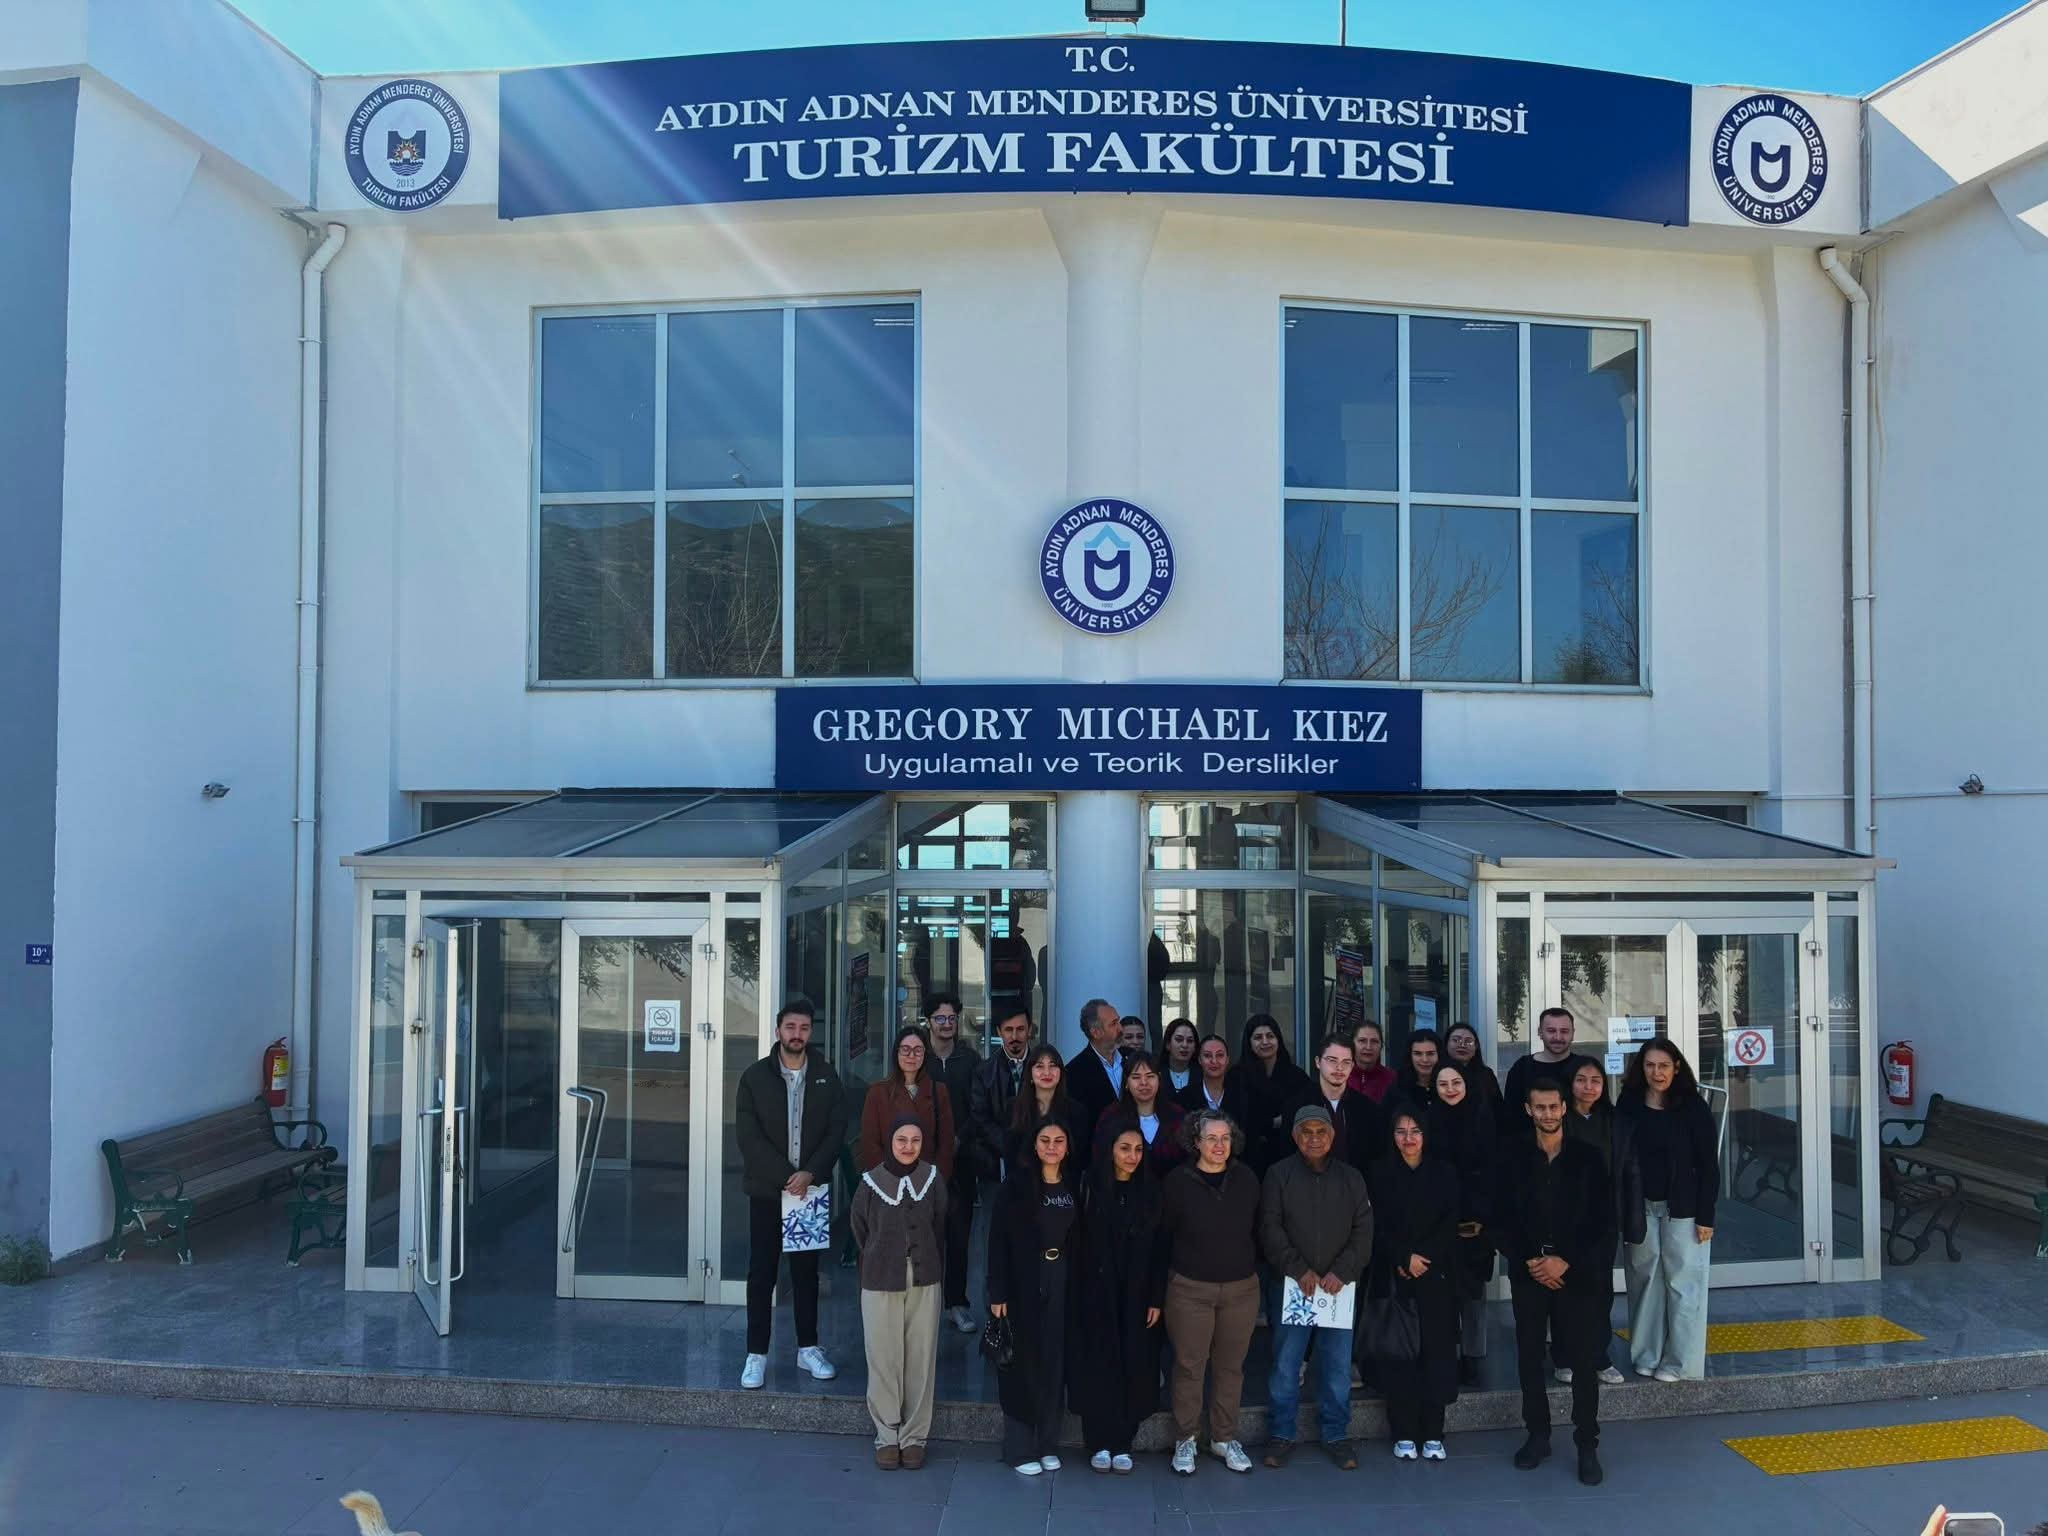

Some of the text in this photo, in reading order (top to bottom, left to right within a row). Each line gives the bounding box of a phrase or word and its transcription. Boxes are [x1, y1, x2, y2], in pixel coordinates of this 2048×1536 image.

[1065, 46, 1135, 73] T.C.
[350, 84, 465, 155] AYDIN ADNAN MENDERES ÜNİVERSİTESİ
[655, 84, 1529, 135] AYDIN ADNAN MENDERES ÜNİVERSİTESİ
[733, 122, 1455, 186] TURİZM FAKÜLTESİ
[1716, 99, 1824, 176] AYDIN ADNAN MENDERES
[361, 175, 451, 207] TURİZM FAKÜLTESİ
[396, 178, 415, 188] 2013
[1723, 176, 1817, 220] ÜNİVERSİTESİ
[1046, 505, 1168, 578] AYDIN ADNAN MENDERES
[1054, 587, 1162, 629] ÜNİVERSİTESİ
[812, 707, 1389, 744] GREGORY MICHAEL KIEZ
[864, 752, 1339, 780] Uygulamalı ve Teorik Derslikler
